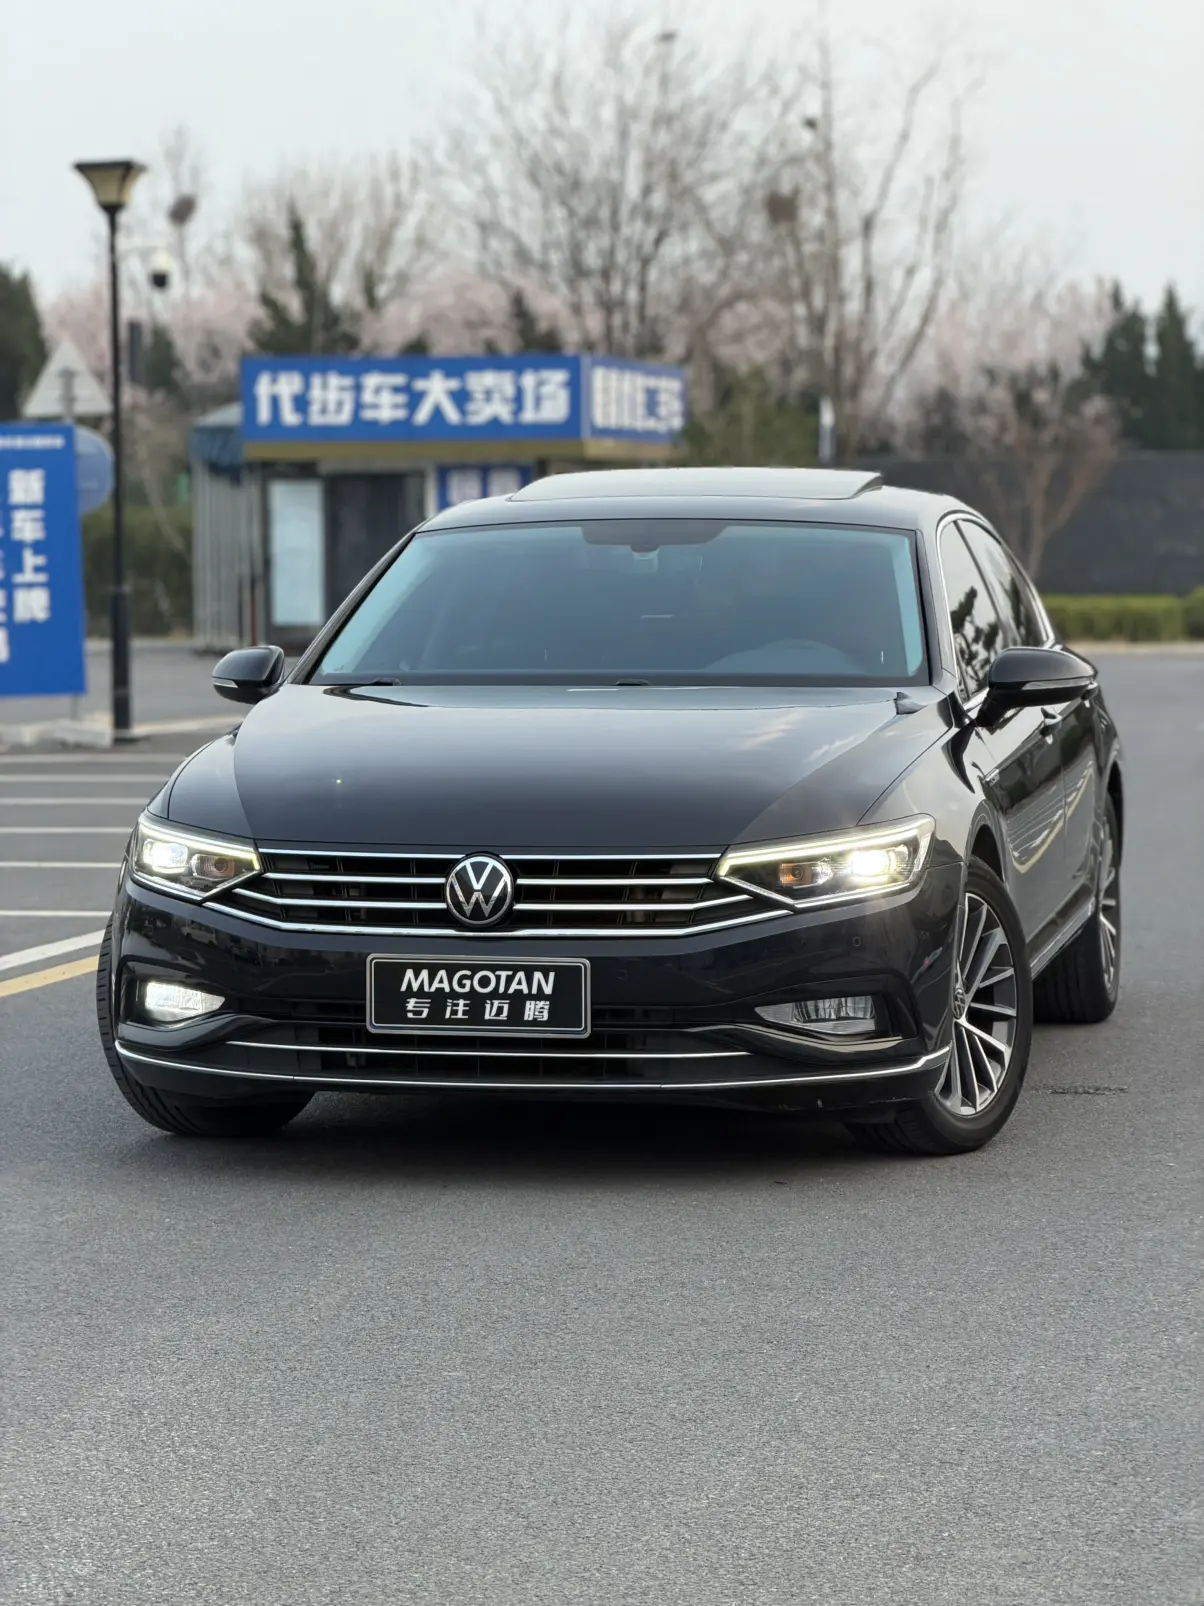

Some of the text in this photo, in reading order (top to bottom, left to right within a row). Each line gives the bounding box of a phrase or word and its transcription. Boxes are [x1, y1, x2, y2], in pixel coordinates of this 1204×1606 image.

[254, 369, 570, 427] 代步车大卖场
[400, 968, 555, 995] MAGOTAN
